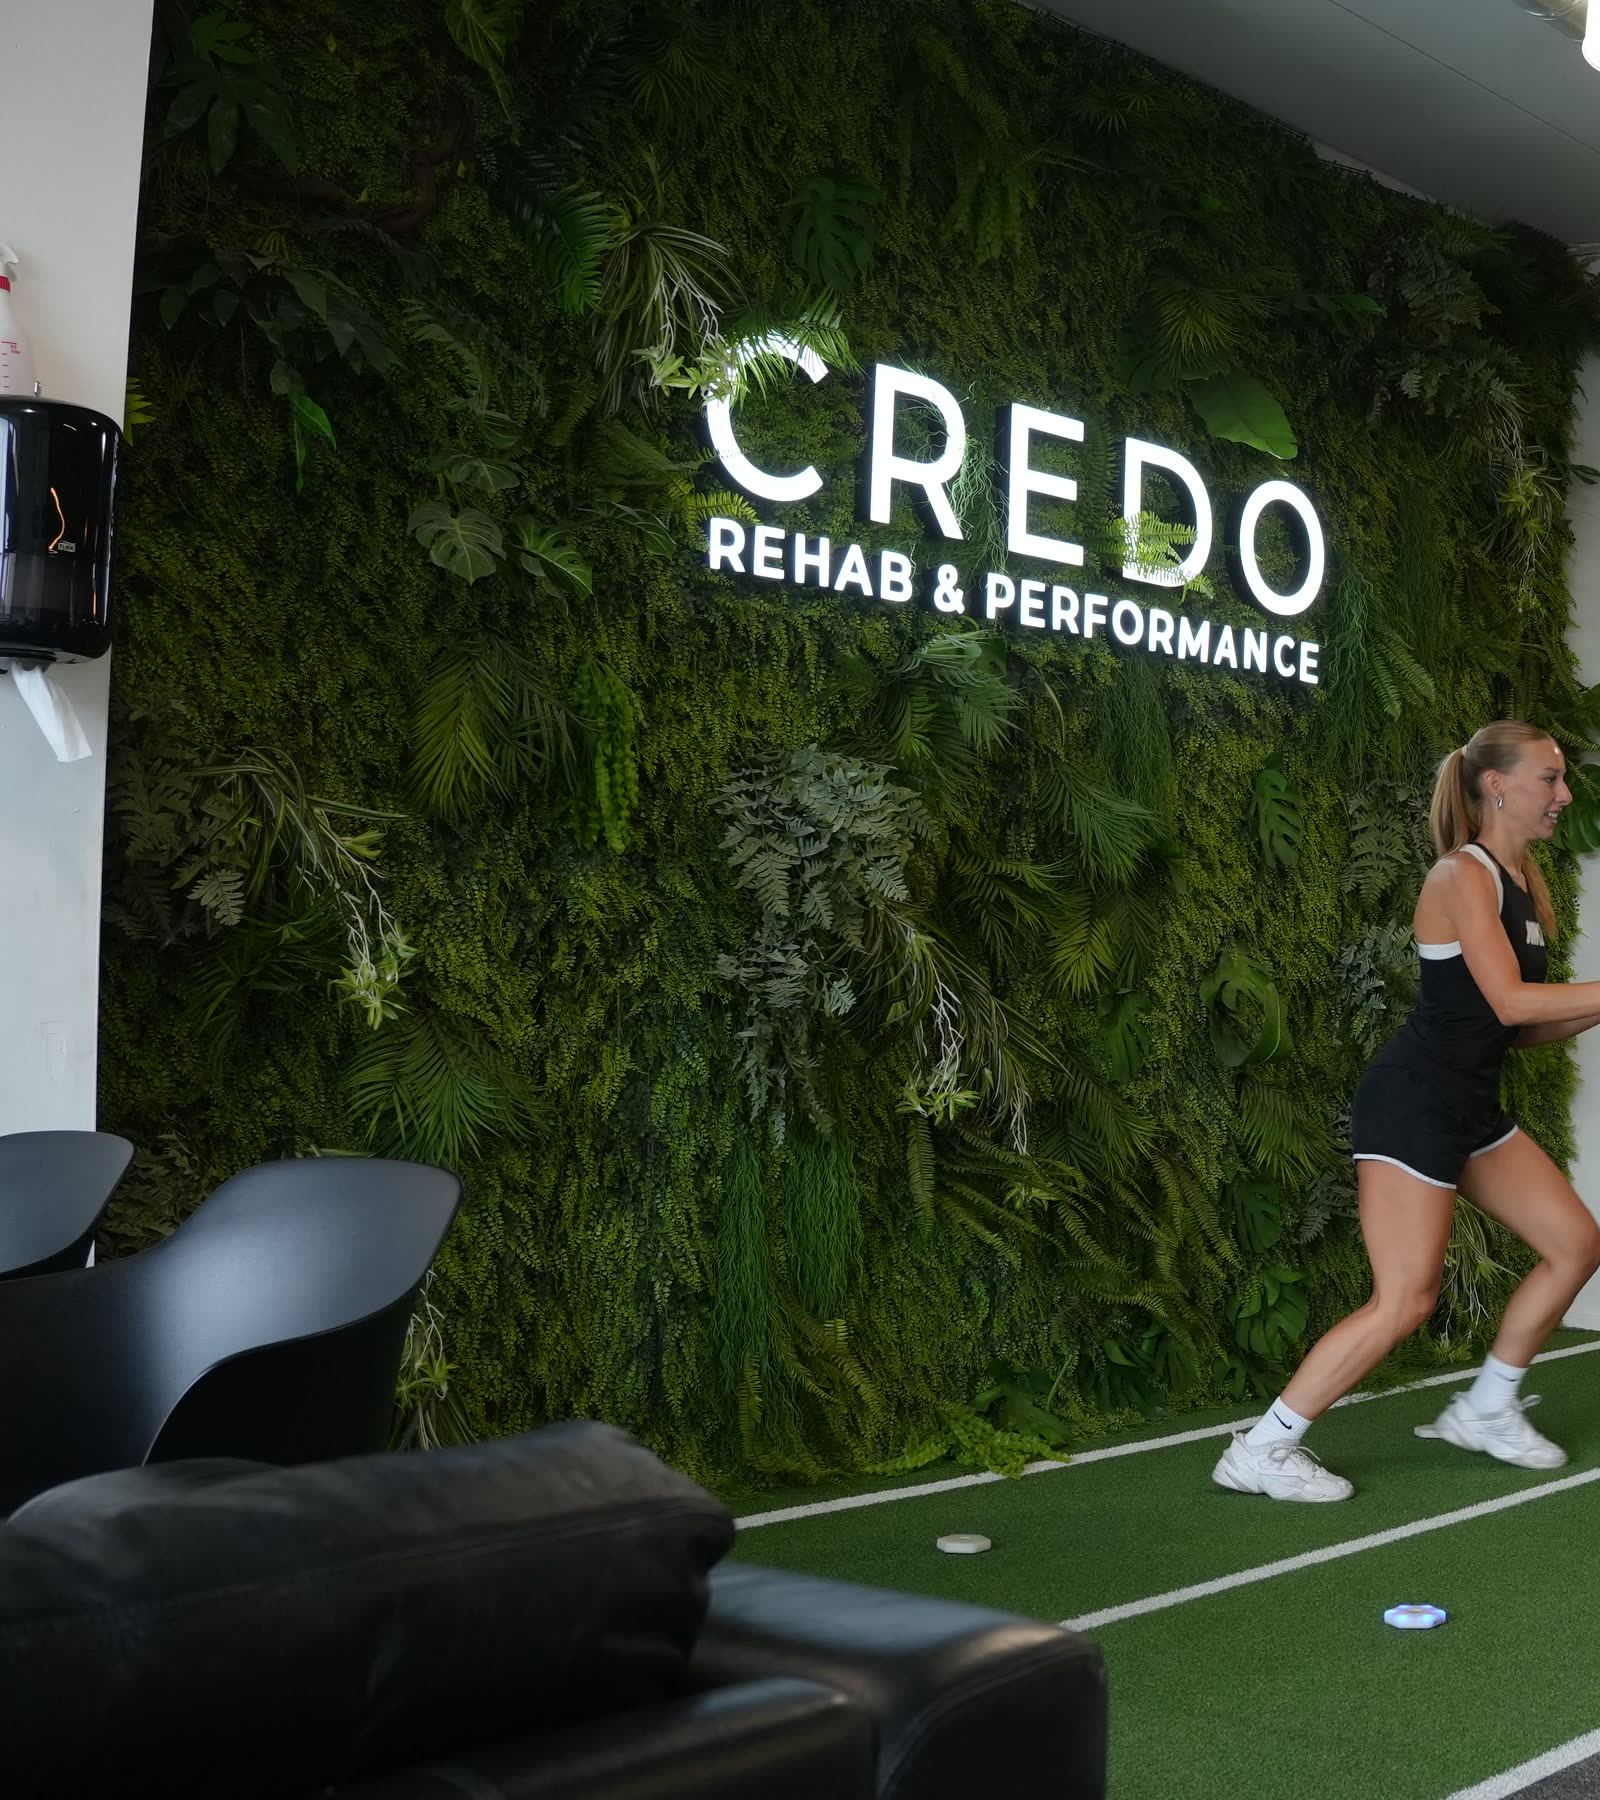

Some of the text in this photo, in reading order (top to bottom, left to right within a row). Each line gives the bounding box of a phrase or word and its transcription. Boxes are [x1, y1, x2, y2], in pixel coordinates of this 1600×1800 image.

[705, 332, 1325, 616] CREDO
[708, 517, 1320, 684] REHAB & PERFORMANCE
